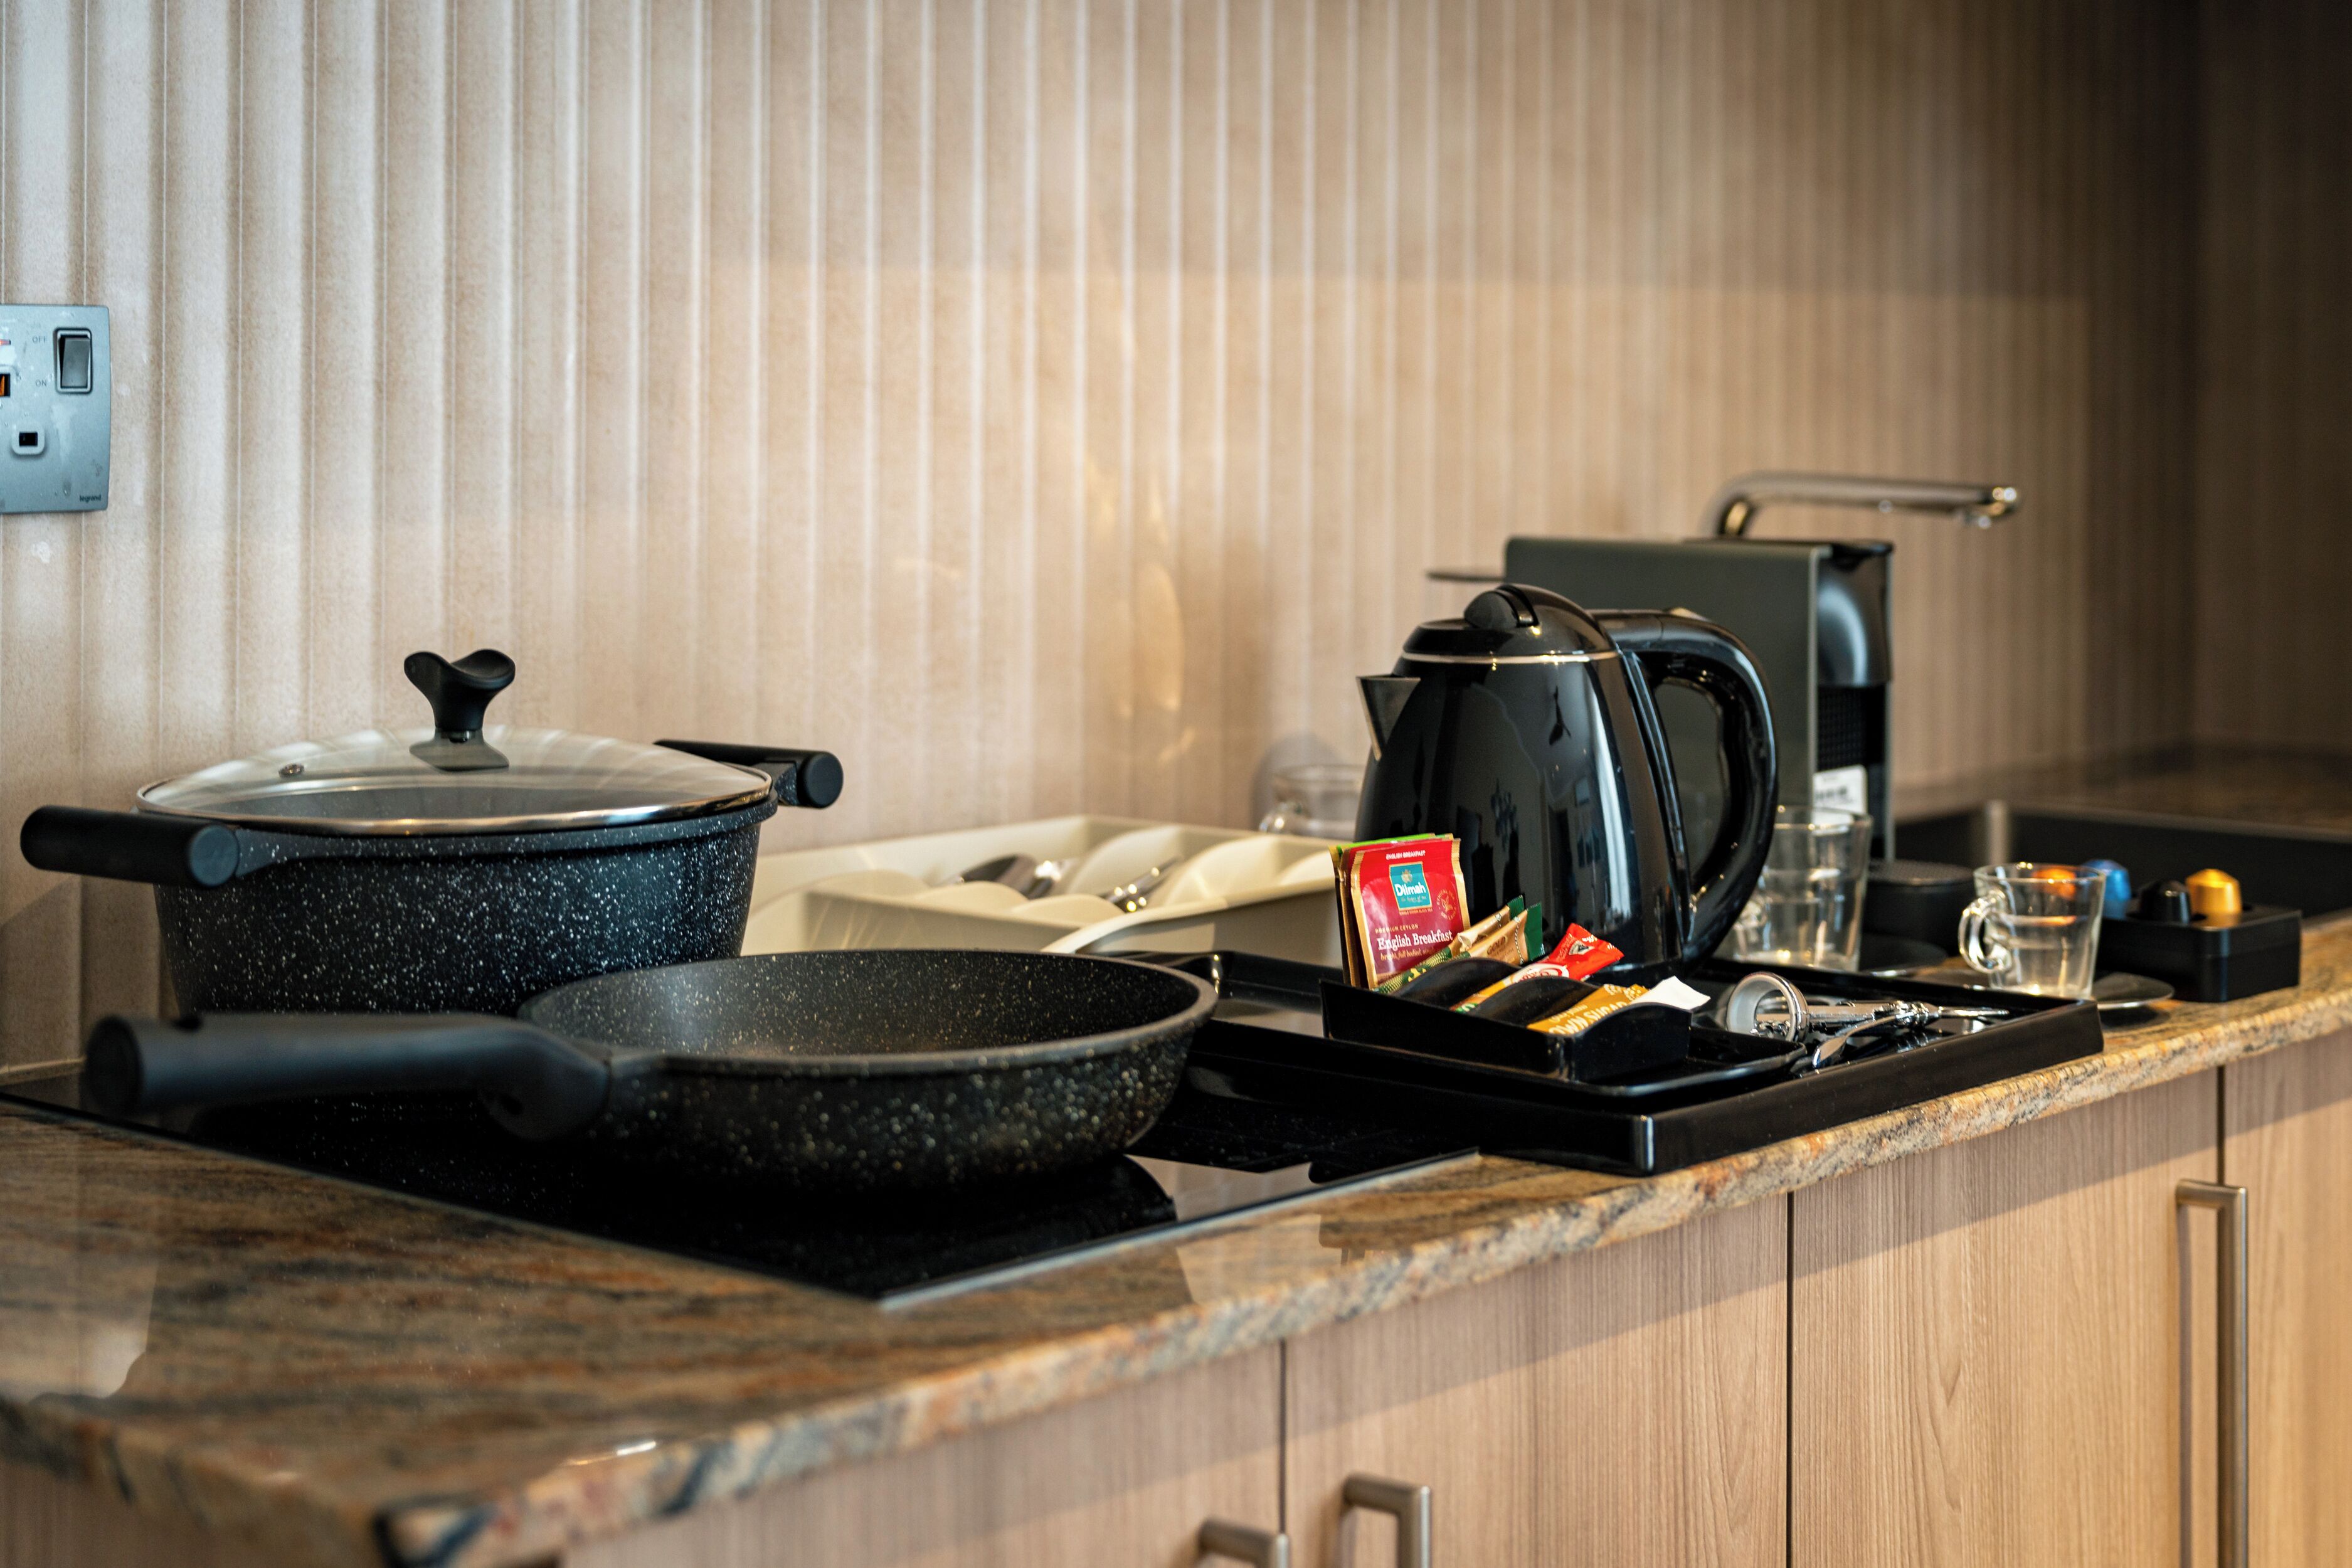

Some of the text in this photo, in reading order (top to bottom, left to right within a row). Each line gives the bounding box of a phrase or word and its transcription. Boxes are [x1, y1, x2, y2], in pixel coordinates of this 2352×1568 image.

[79, 493, 102, 504] legrand
[1385, 850, 1426, 861] ENGLISH BREAKFAST
[1394, 882, 1427, 896] Dilmah
[1375, 923, 1419, 935] PREMIUM CEYLON
[1377, 933, 1412, 951] English
[1412, 929, 1453, 946] Breakfast
[1487, 936, 1507, 955] GOLD
